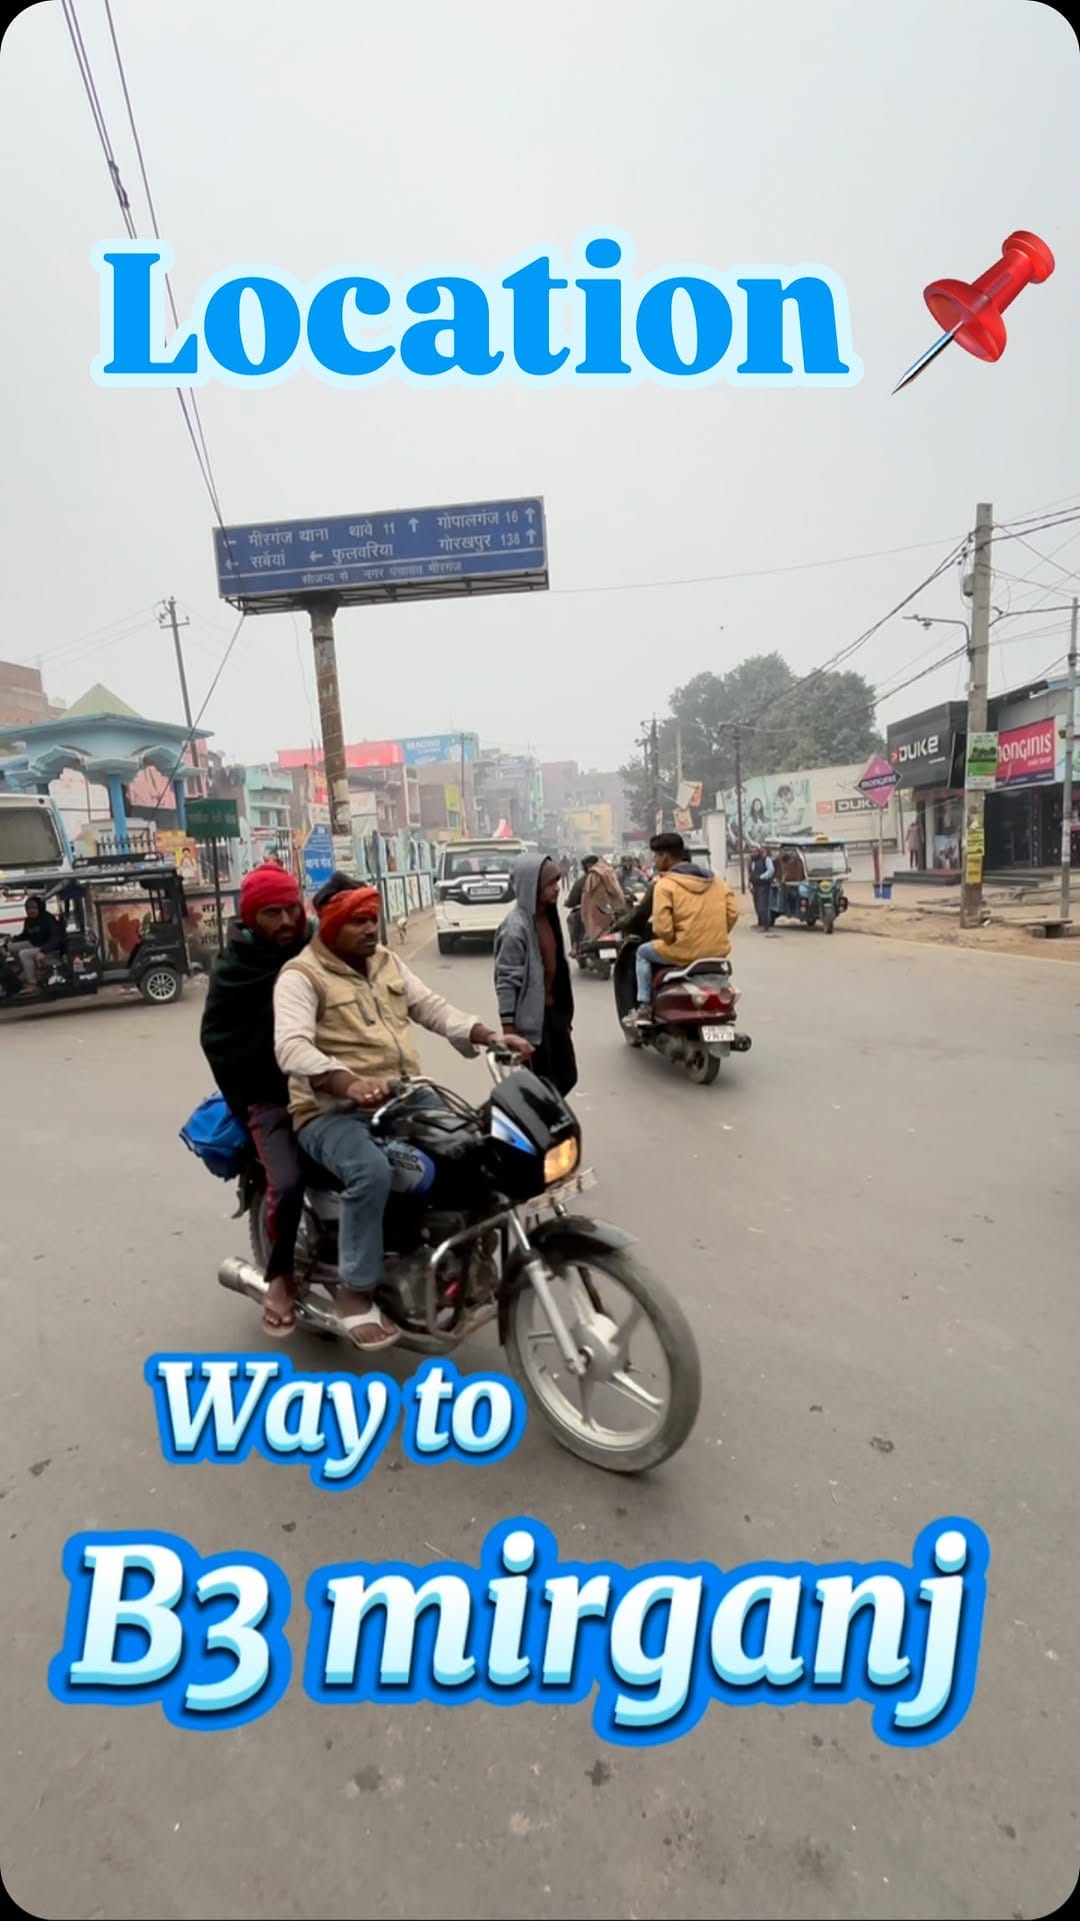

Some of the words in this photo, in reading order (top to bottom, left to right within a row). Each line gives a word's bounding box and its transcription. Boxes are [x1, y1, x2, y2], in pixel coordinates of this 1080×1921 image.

[505, 511, 519, 524] 16
[349, 520, 373, 537] थावे
[384, 522, 395, 535] 11
[248, 528, 293, 548] मीरगंज
[300, 528, 329, 542] थाना
[438, 534, 492, 552] गोरखपुर
[500, 532, 521, 546] 138
[331, 541, 394, 565] फुलवरिया
[364, 567, 384, 580] नगर
[898, 735, 939, 763] DUKE
[838, 799, 876, 811] DUK
